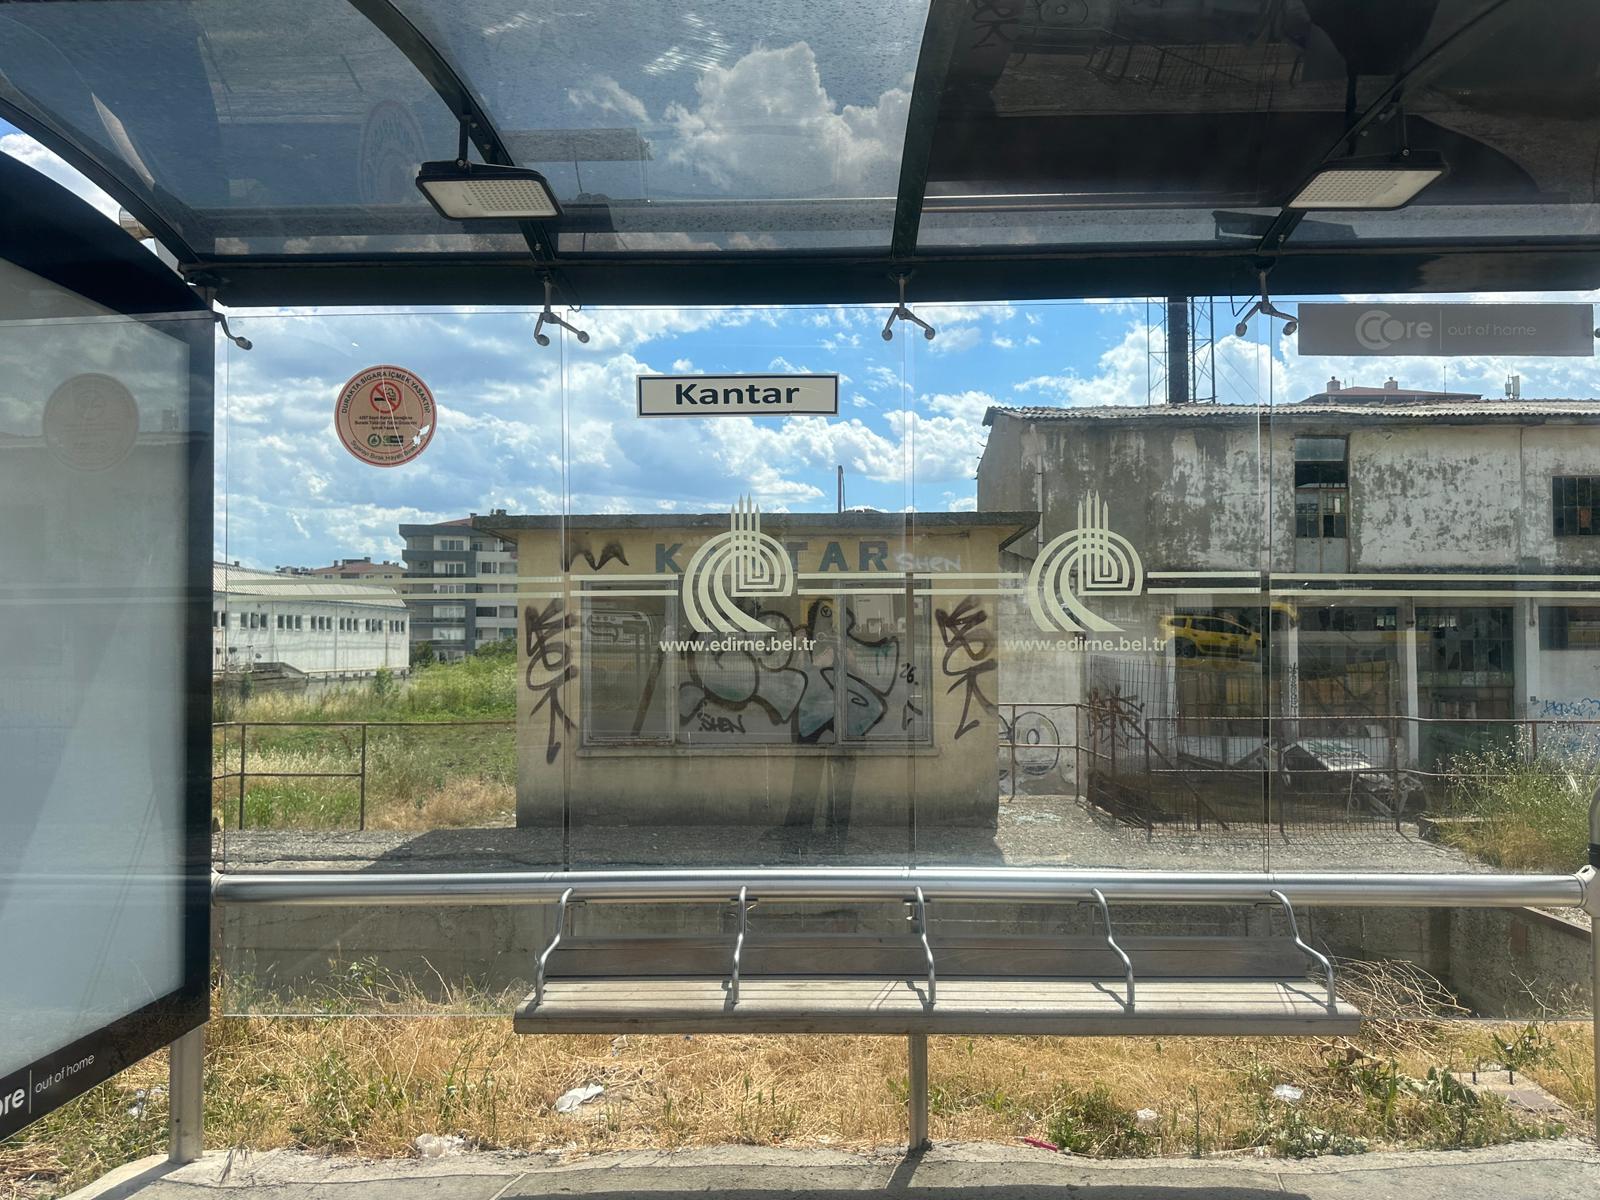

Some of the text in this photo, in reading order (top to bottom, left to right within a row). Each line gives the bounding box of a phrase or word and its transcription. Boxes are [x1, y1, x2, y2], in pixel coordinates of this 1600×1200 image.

[1448, 325, 1474, 337] out
[1475, 323, 1492, 337] of
[1493, 323, 1537, 337] home
[341, 383, 361, 414] DURAKTA
[388, 371, 411, 384] İÇMEK
[675, 383, 800, 405] Kantar
[659, 636, 817, 652] www.edirne.bel.tr
[1004, 636, 1168, 652] www.edirne.bel.tr
[35, 1075, 53, 1093] out
[54, 1066, 66, 1083] of
[66, 1054, 95, 1077] home
